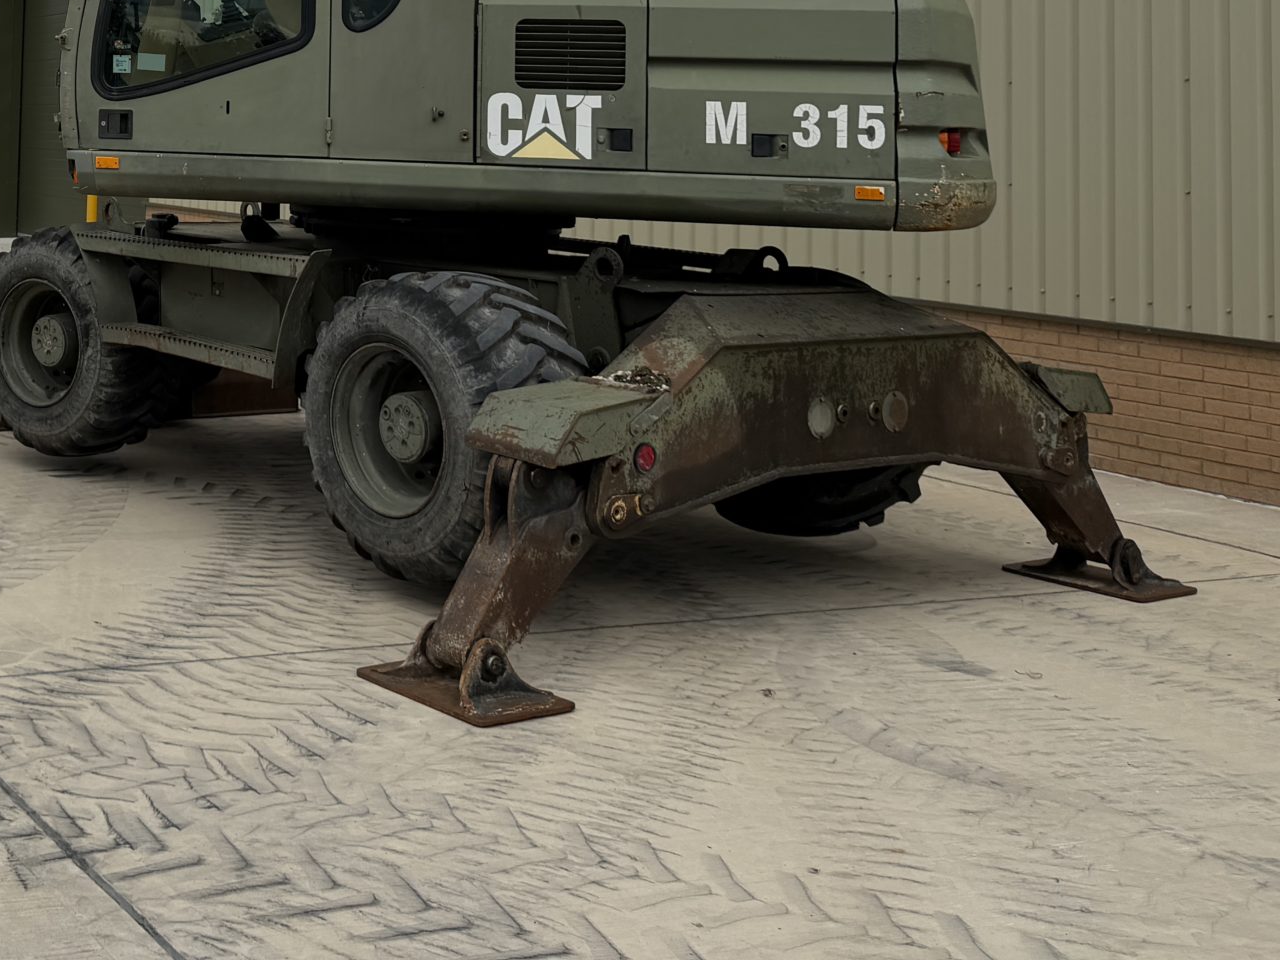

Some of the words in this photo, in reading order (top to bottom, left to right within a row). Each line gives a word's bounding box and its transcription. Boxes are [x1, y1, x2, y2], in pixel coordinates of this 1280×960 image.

[487, 92, 602, 160] CAT
[705, 100, 747, 145] M
[792, 103, 886, 150] 315
